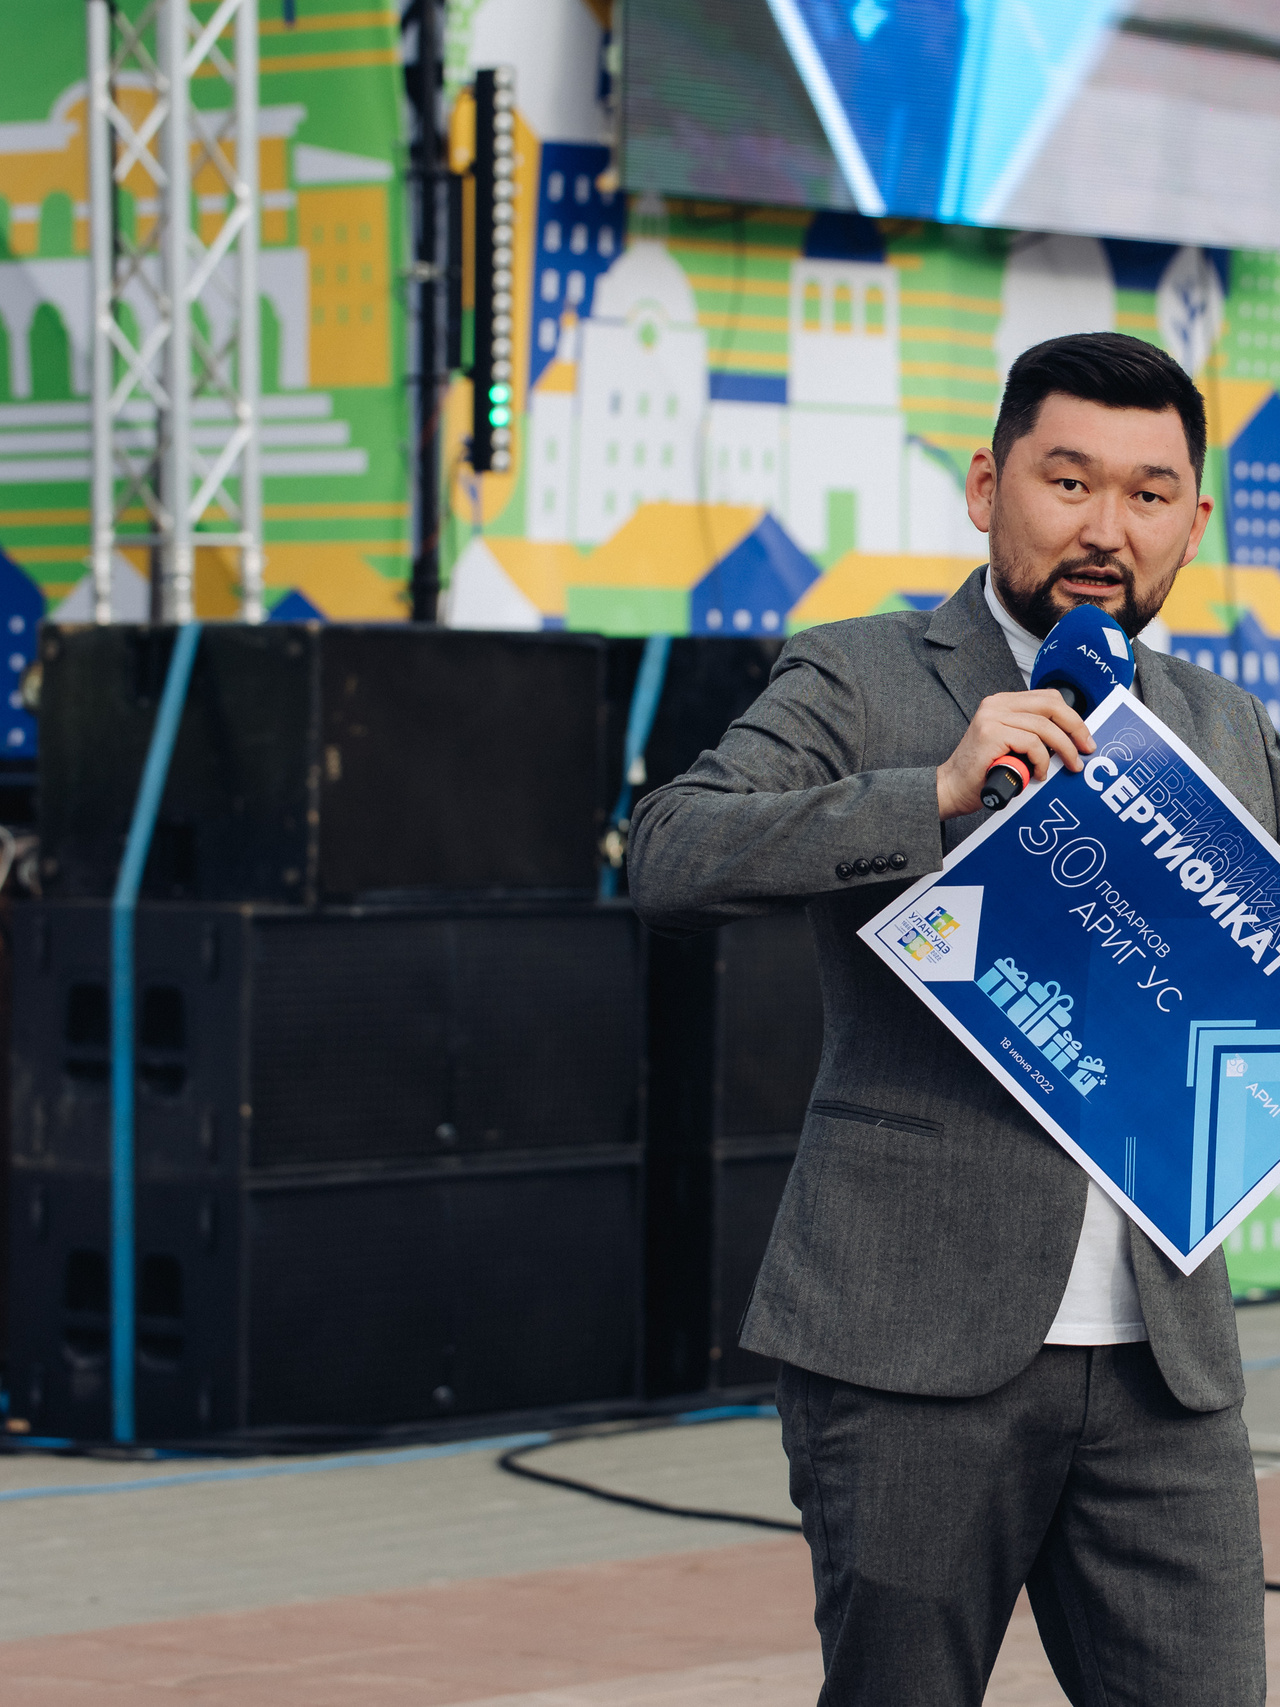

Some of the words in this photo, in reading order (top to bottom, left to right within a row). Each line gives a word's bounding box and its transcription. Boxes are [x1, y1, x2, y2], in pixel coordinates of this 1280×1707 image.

[1077, 644, 1119, 688] АРИГУ
[1019, 798, 1107, 888] 30
[908, 911, 951, 955] УЛАН-УДЭ
[1095, 880, 1171, 958] ПОДАРКОВ
[1068, 901, 1147, 965] АРИГ
[1137, 965, 1183, 1012] УС
[1000, 1036, 1012, 1050] 18
[1008, 1048, 1033, 1073] июня
[1030, 1069, 1055, 1095] 2022
